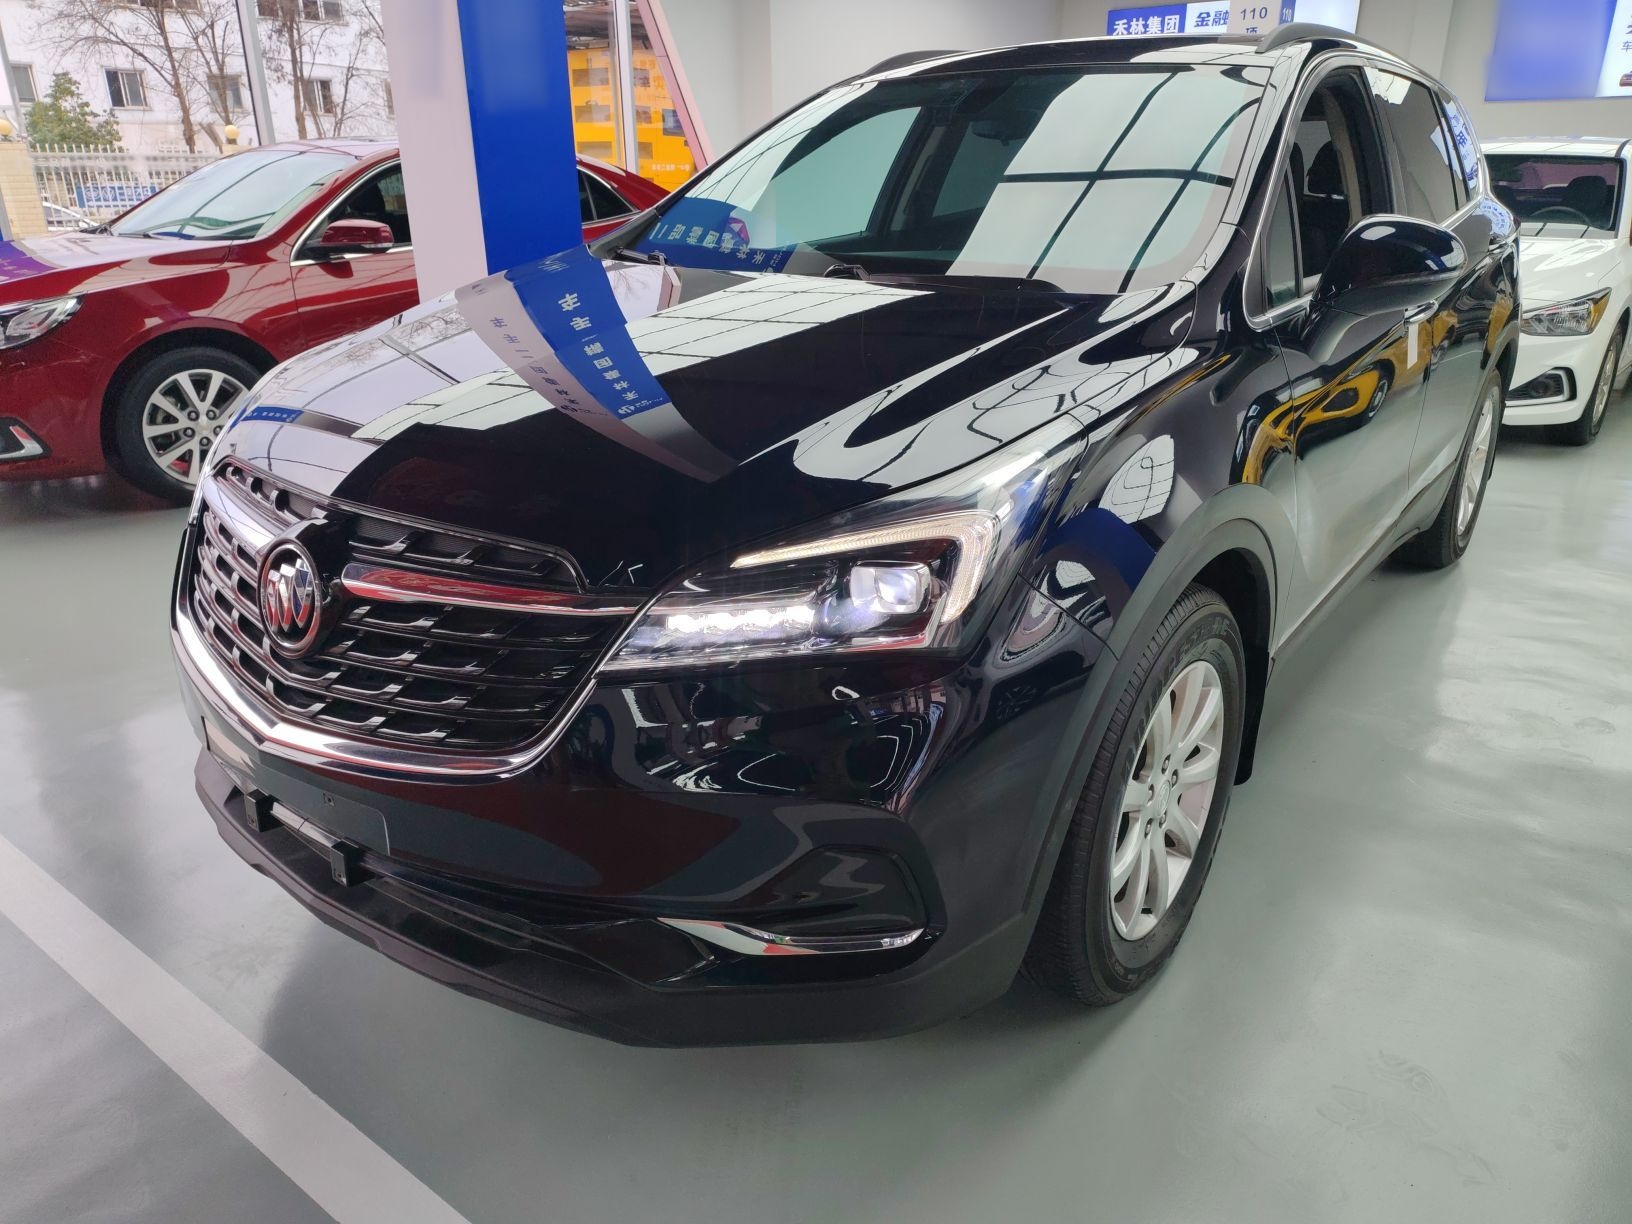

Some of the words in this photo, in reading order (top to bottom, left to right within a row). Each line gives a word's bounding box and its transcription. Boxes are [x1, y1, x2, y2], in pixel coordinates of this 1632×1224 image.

[1240, 7, 1268, 21] 110
[1113, 15, 1180, 36] 禾林集团
